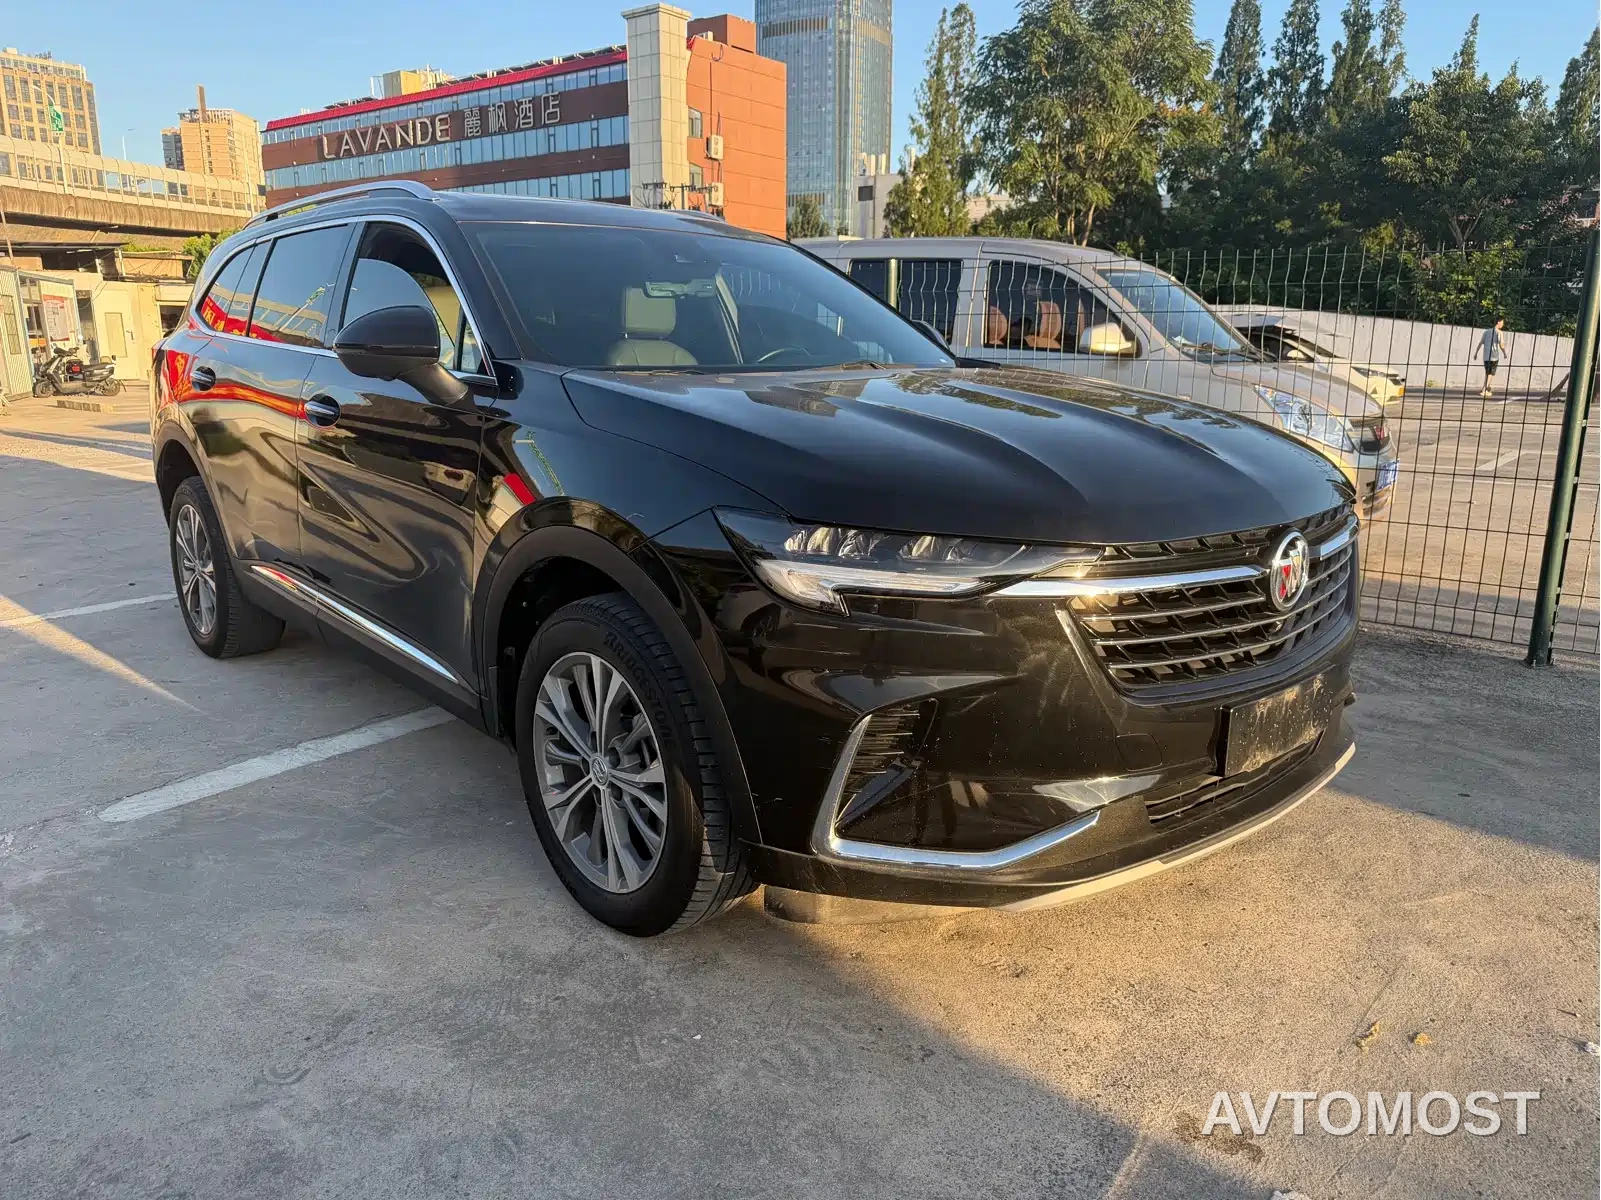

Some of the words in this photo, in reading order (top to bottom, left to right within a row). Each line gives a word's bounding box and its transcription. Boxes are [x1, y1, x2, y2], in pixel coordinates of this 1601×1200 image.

[322, 113, 450, 159] LAVANDE
[463, 92, 561, 138] 麗枫酒店
